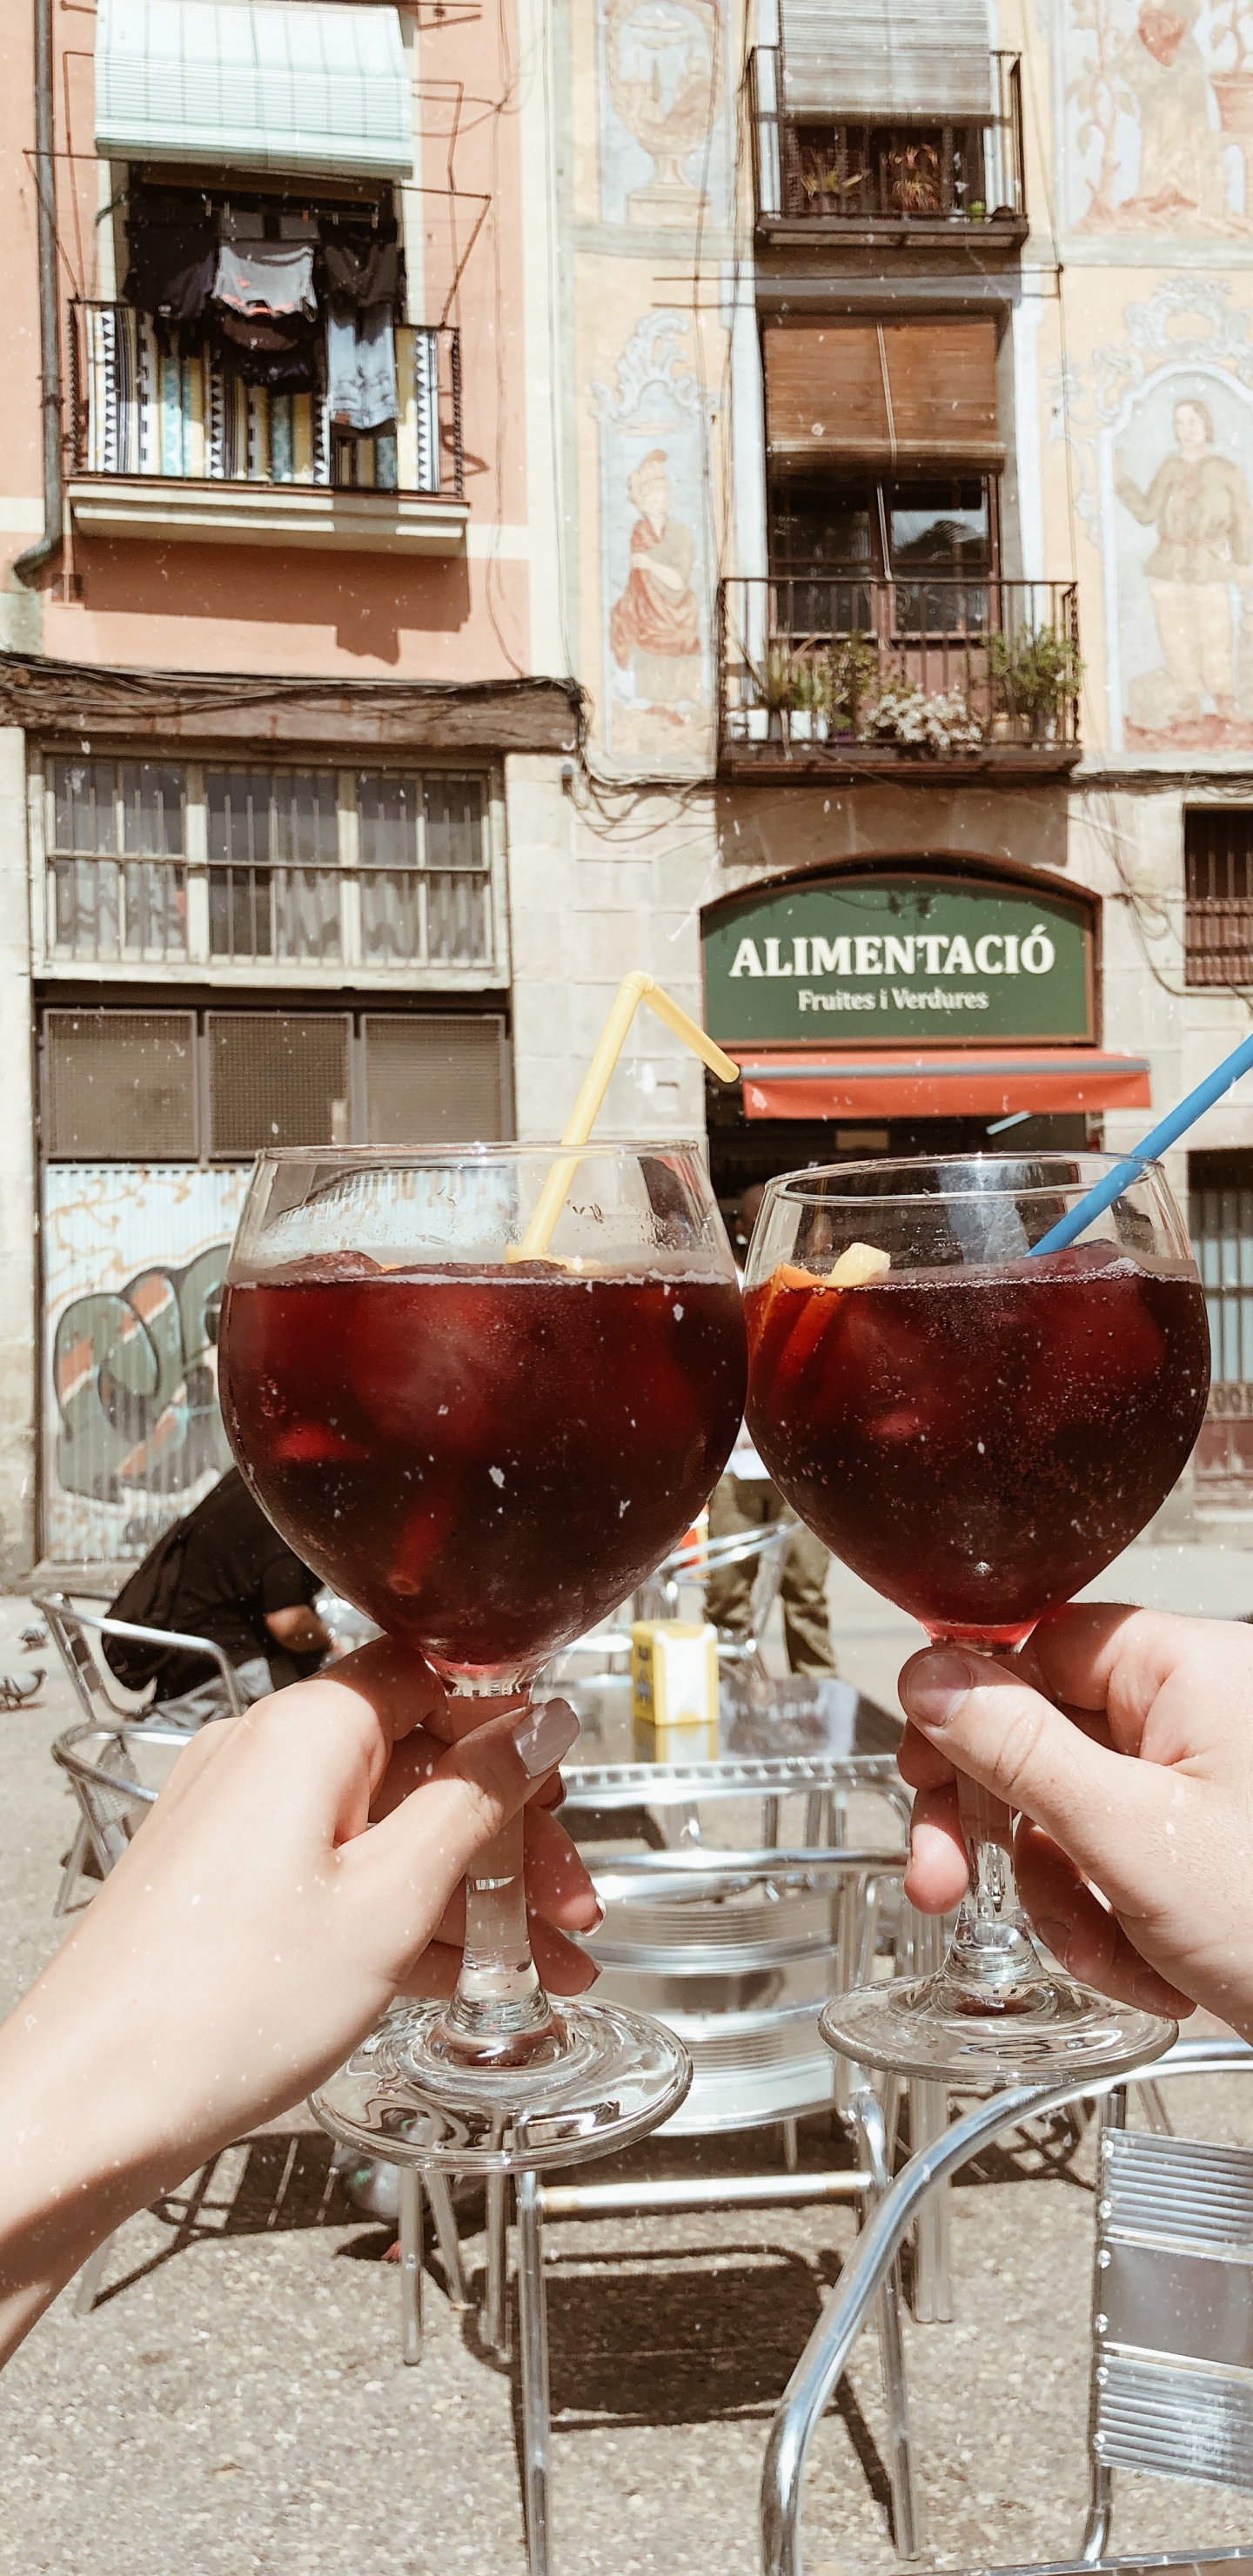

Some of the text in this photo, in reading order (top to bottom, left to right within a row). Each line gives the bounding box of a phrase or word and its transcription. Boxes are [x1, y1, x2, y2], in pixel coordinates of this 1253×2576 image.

[729, 923, 1055, 976] ALIMENTACIÓ
[797, 986, 989, 1011] Fruites i Verdures
